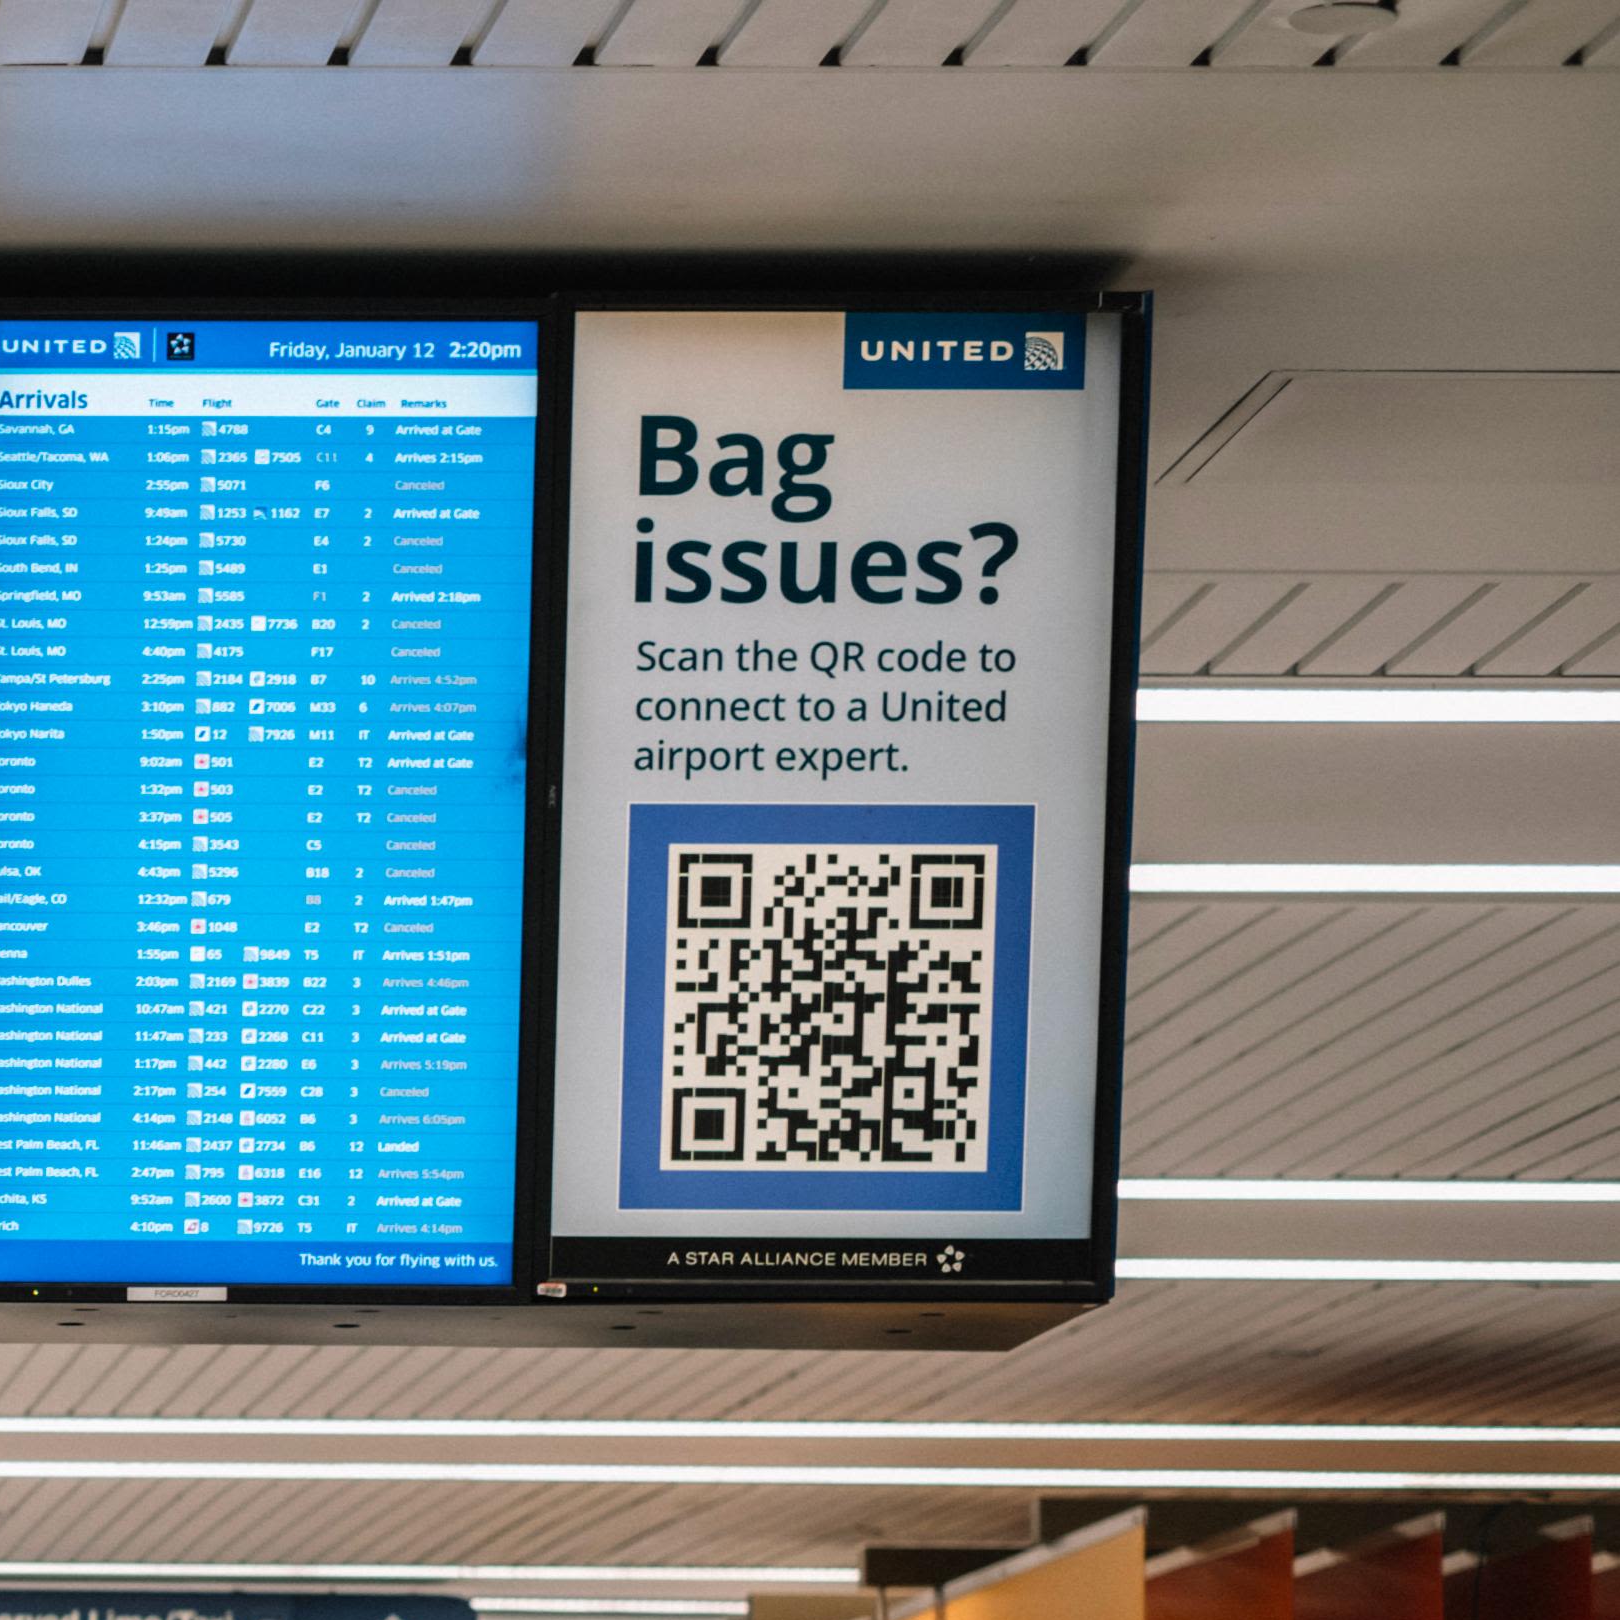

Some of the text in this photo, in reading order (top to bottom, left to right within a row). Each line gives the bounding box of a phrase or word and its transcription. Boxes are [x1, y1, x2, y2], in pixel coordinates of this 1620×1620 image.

[3, 340, 107, 353] UNITED
[270, 342, 521, 360] Friday, January 12 2:20pm
[861, 341, 1013, 361] UNITED
[639, 415, 835, 523] Bag
[635, 517, 1018, 605] issues?
[637, 640, 1015, 678] Scan the QR code to
[636, 690, 1006, 722] connect to a United
[635, 740, 907, 780] airport expert.
[137, 949, 179, 961] 1:55pm
[205, 947, 222, 960] 65
[304, 950, 319, 960] T5
[382, 950, 424, 961] Arrives
[428, 950, 470, 962] 1:51pm
[299, 1253, 497, 1268] Thank you for flying with us.
[667, 1252, 927, 1266] A STAR ALLIANCE MEMBER
